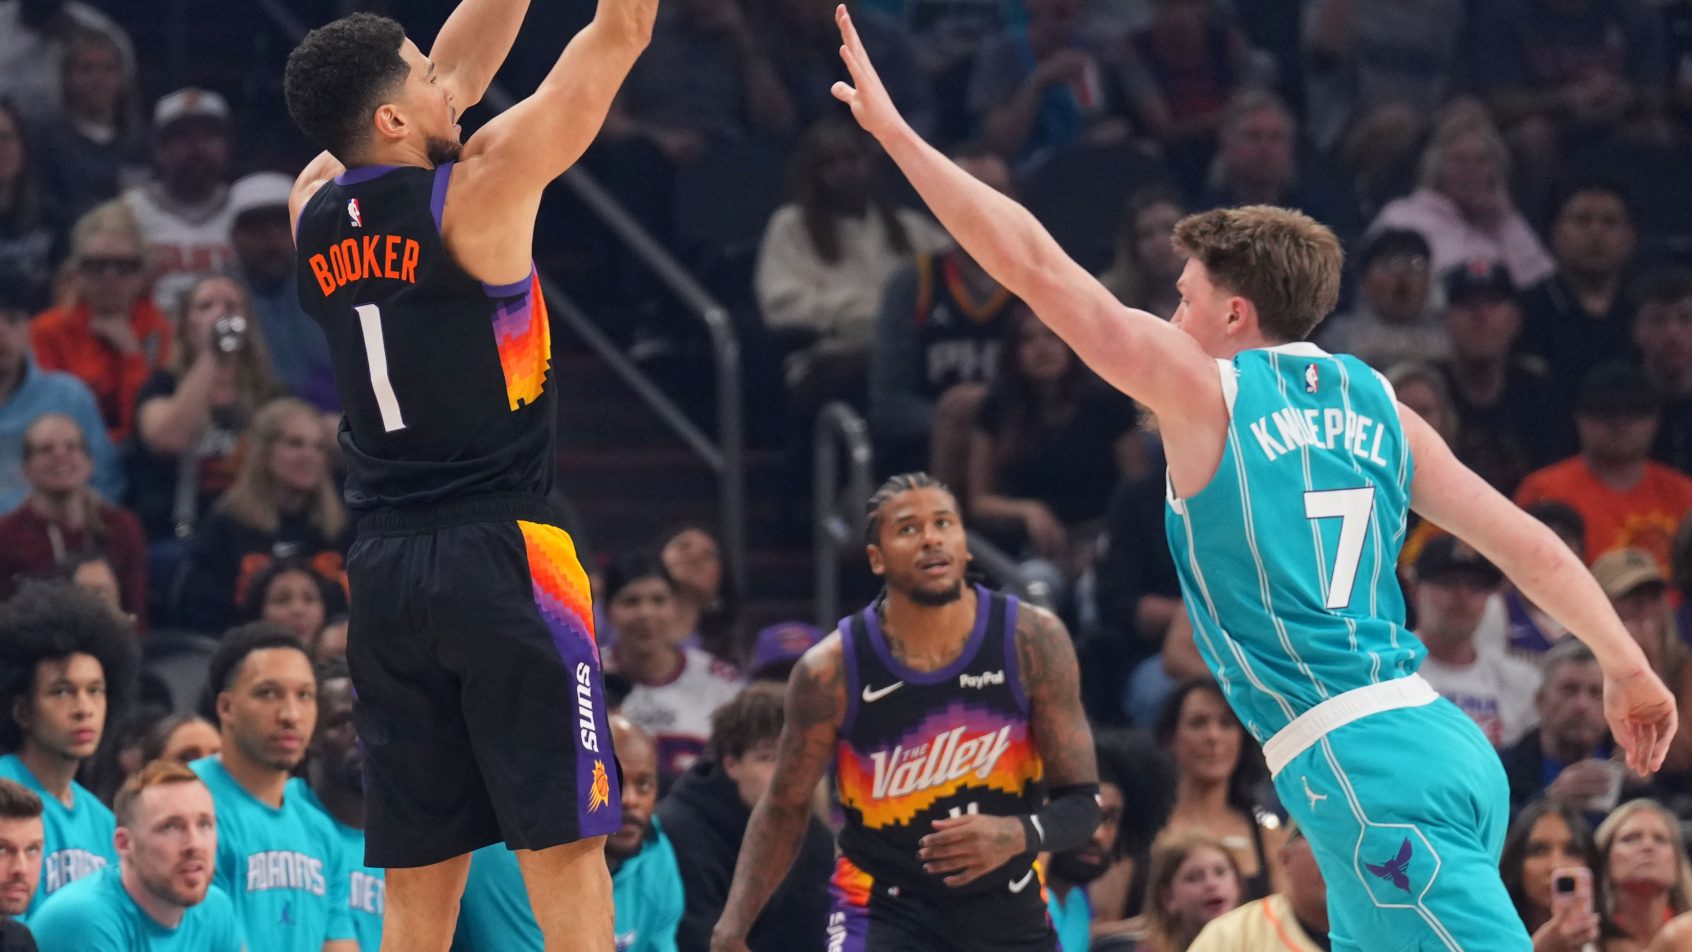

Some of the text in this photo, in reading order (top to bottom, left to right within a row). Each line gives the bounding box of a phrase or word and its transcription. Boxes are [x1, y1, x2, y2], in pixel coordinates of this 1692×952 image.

[309, 234, 420, 297] BOOKER
[353, 303, 407, 432] 1
[1303, 486, 1376, 610] 7
[959, 670, 1005, 690] PayPal
[870, 724, 1012, 799] Valley
[902, 742, 930, 762] THE
